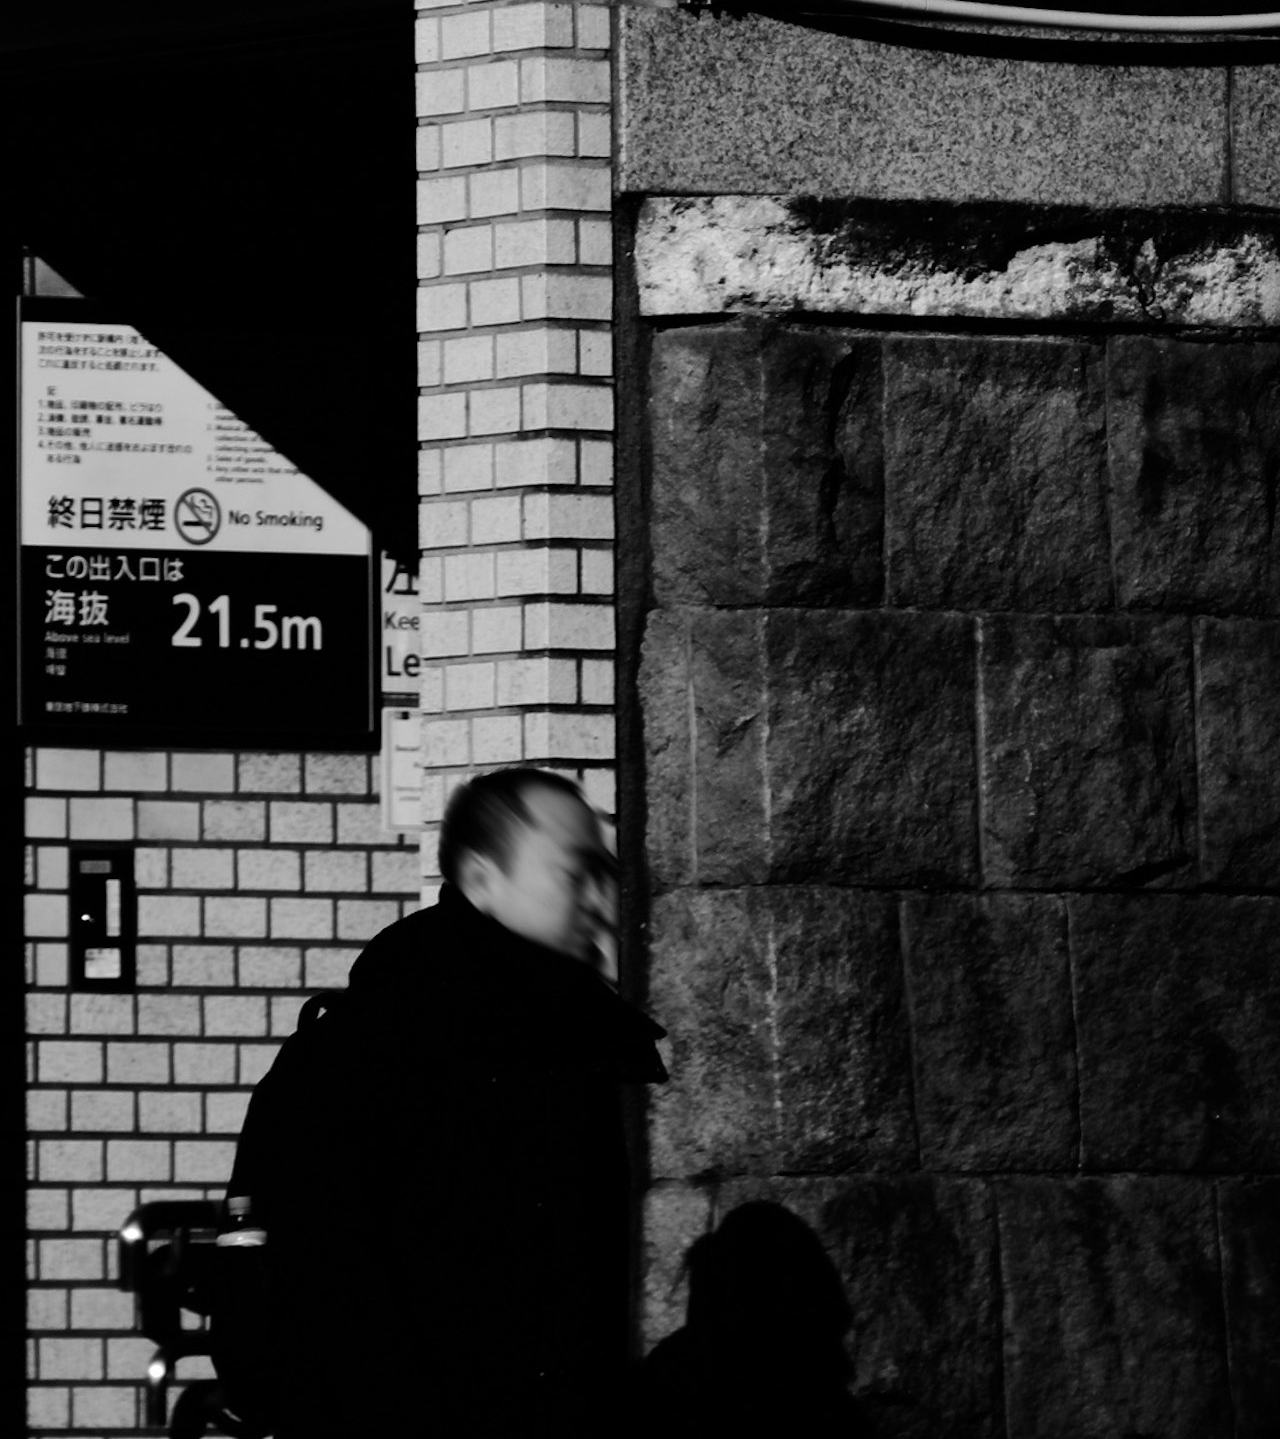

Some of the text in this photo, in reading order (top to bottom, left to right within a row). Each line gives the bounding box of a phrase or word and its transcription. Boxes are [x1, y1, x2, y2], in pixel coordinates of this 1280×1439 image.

[47, 495, 167, 531] 終日禁煙
[228, 509, 324, 532] No Smoking
[45, 554, 185, 582] この出入口は
[44, 589, 110, 626] 海抜
[171, 592, 323, 651] 21.5m
